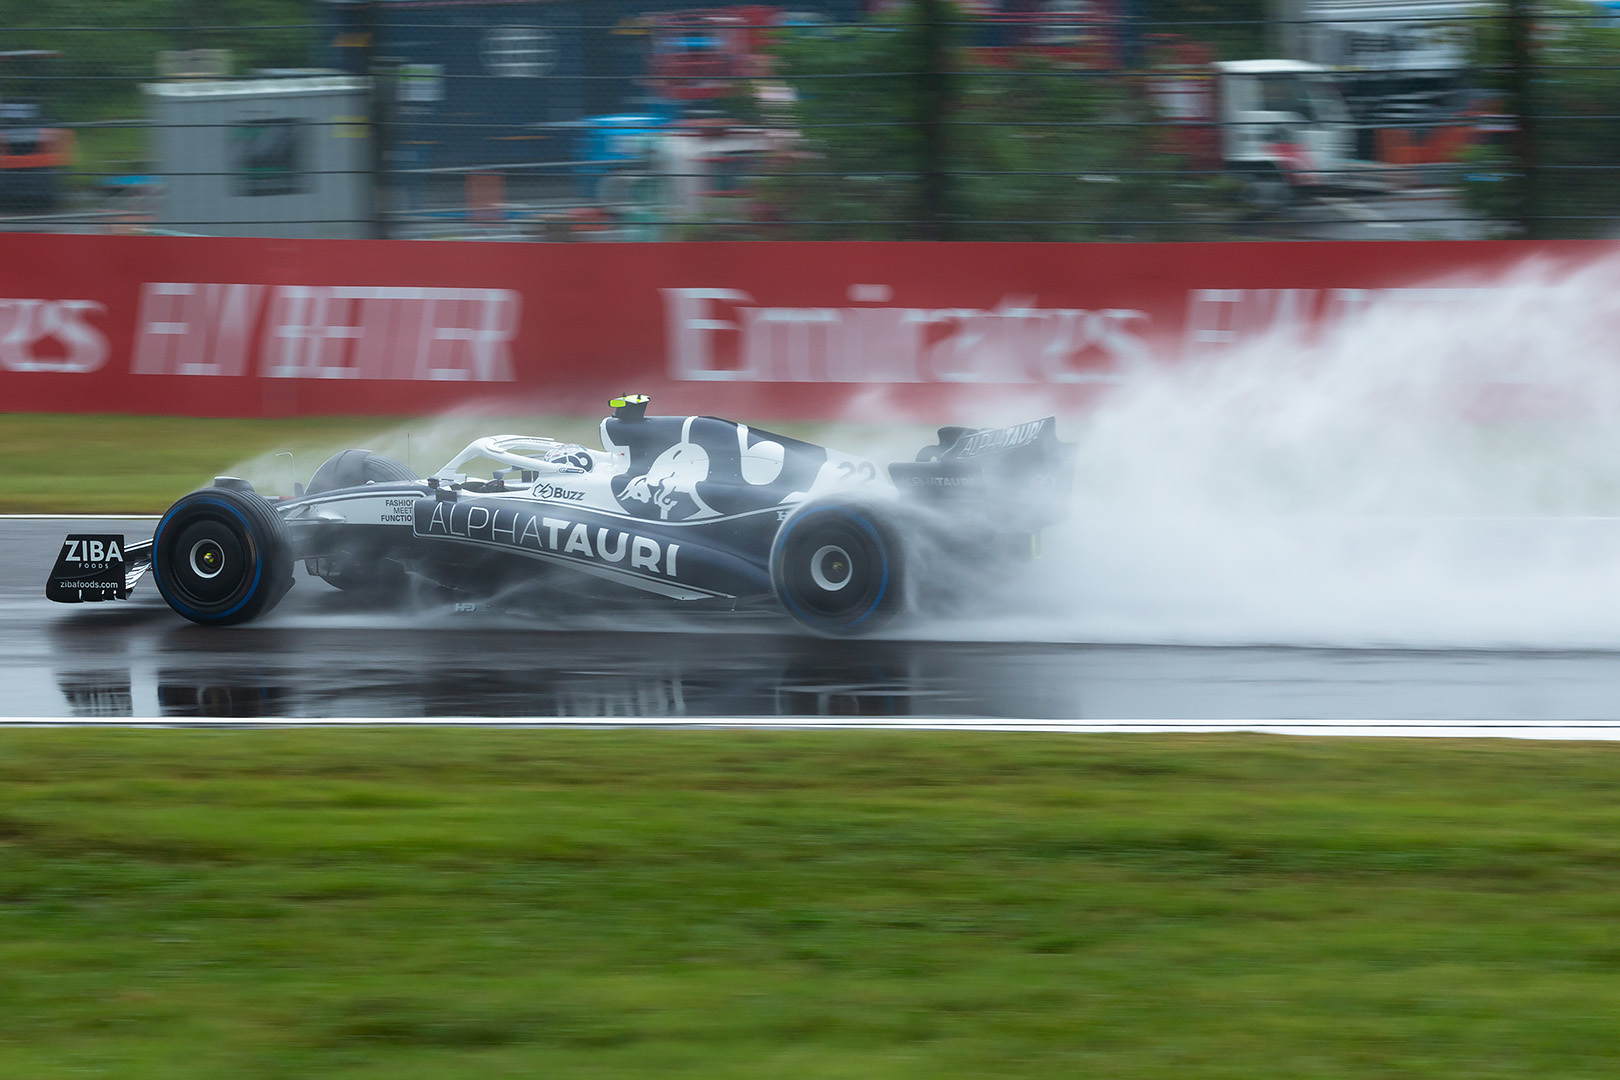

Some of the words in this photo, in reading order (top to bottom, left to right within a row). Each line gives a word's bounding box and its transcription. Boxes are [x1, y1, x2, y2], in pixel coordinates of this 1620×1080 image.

[428, 501, 680, 577] ALPHATAURI
[65, 540, 124, 562] ZIBA
[60, 580, 119, 589] zibafoods.com
